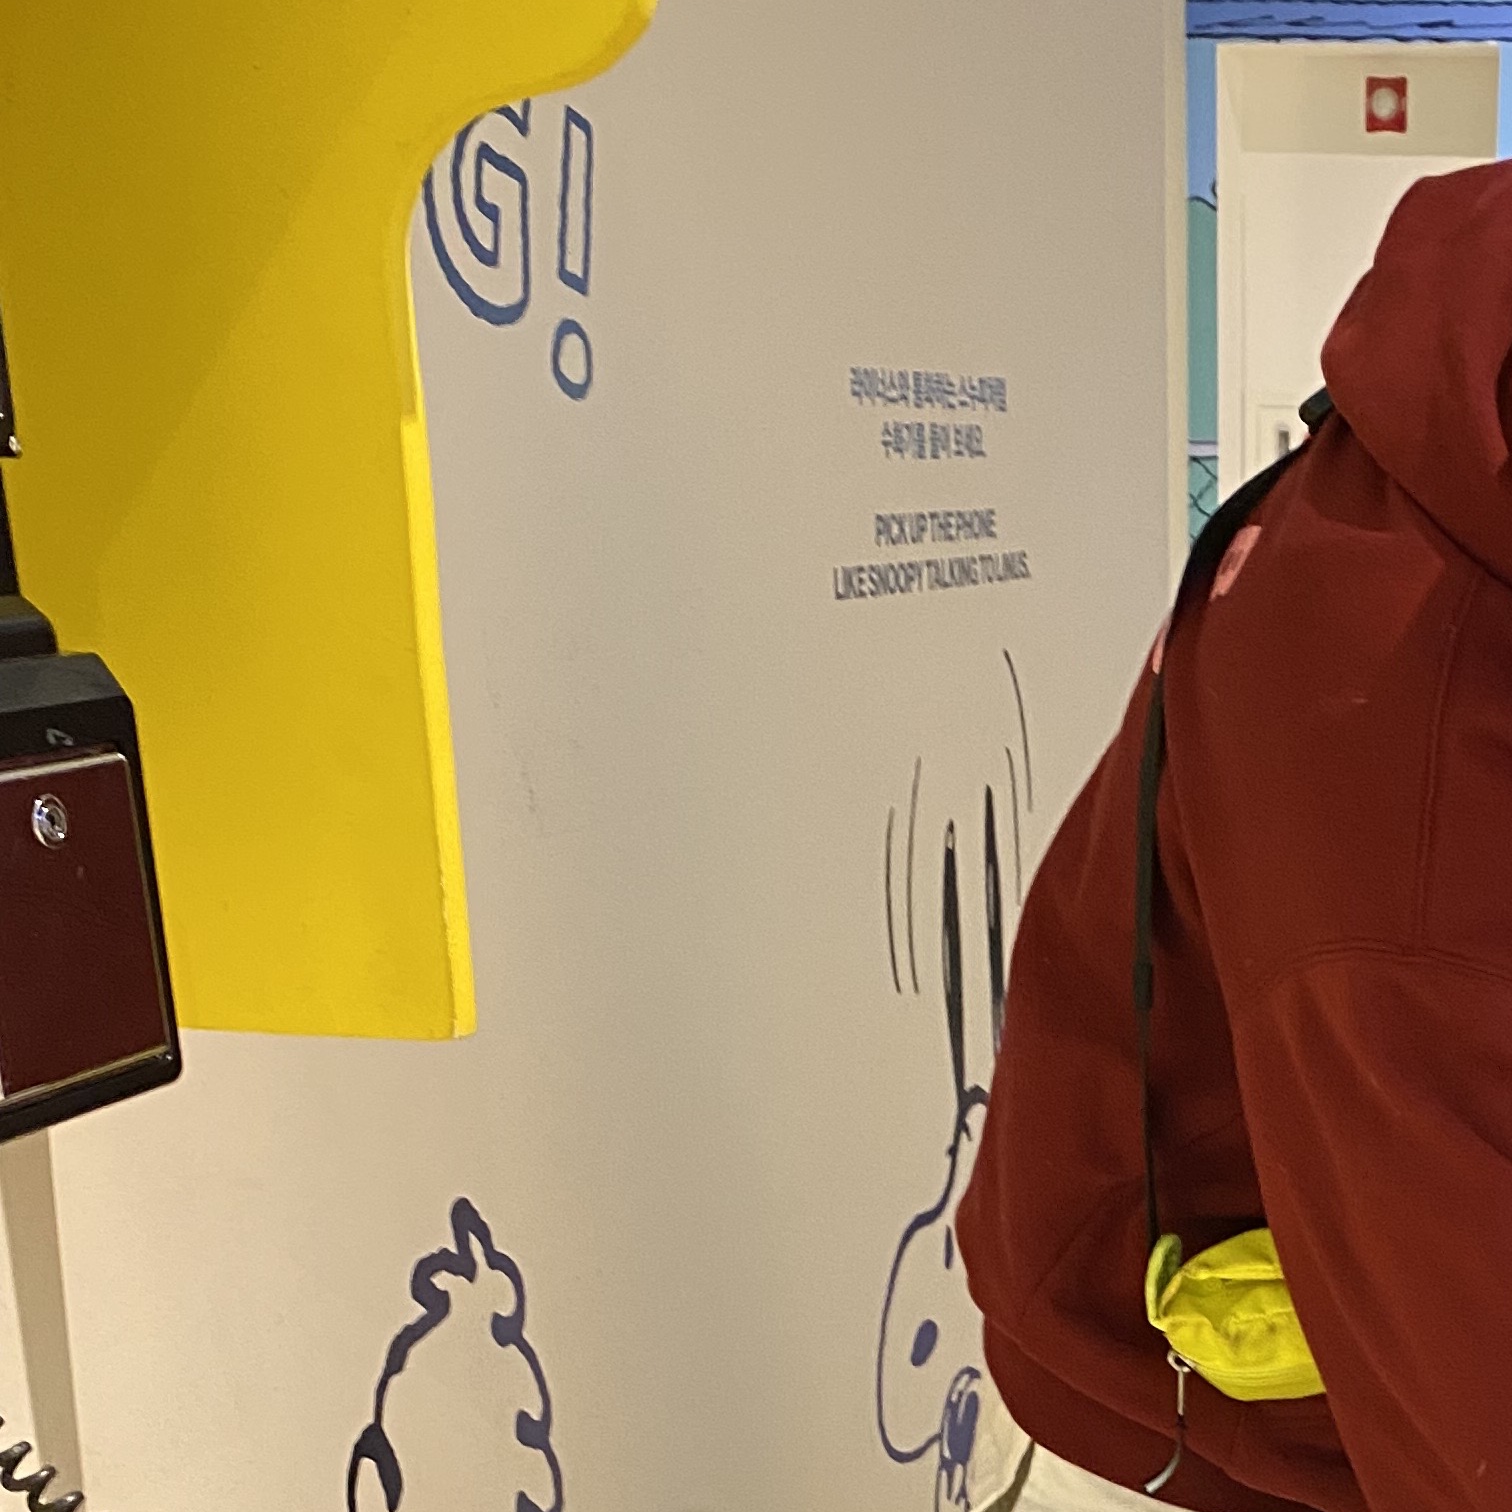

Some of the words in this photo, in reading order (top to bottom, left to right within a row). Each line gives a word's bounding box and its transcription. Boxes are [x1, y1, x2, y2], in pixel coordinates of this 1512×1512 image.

[873, 511, 909, 547] PICK
[909, 510, 928, 545] UP
[928, 508, 956, 543] THE
[956, 506, 997, 541] PHONE
[833, 563, 867, 600] LIKE
[867, 559, 924, 598] SNOOPY
[925, 554, 979, 592] TALKING
